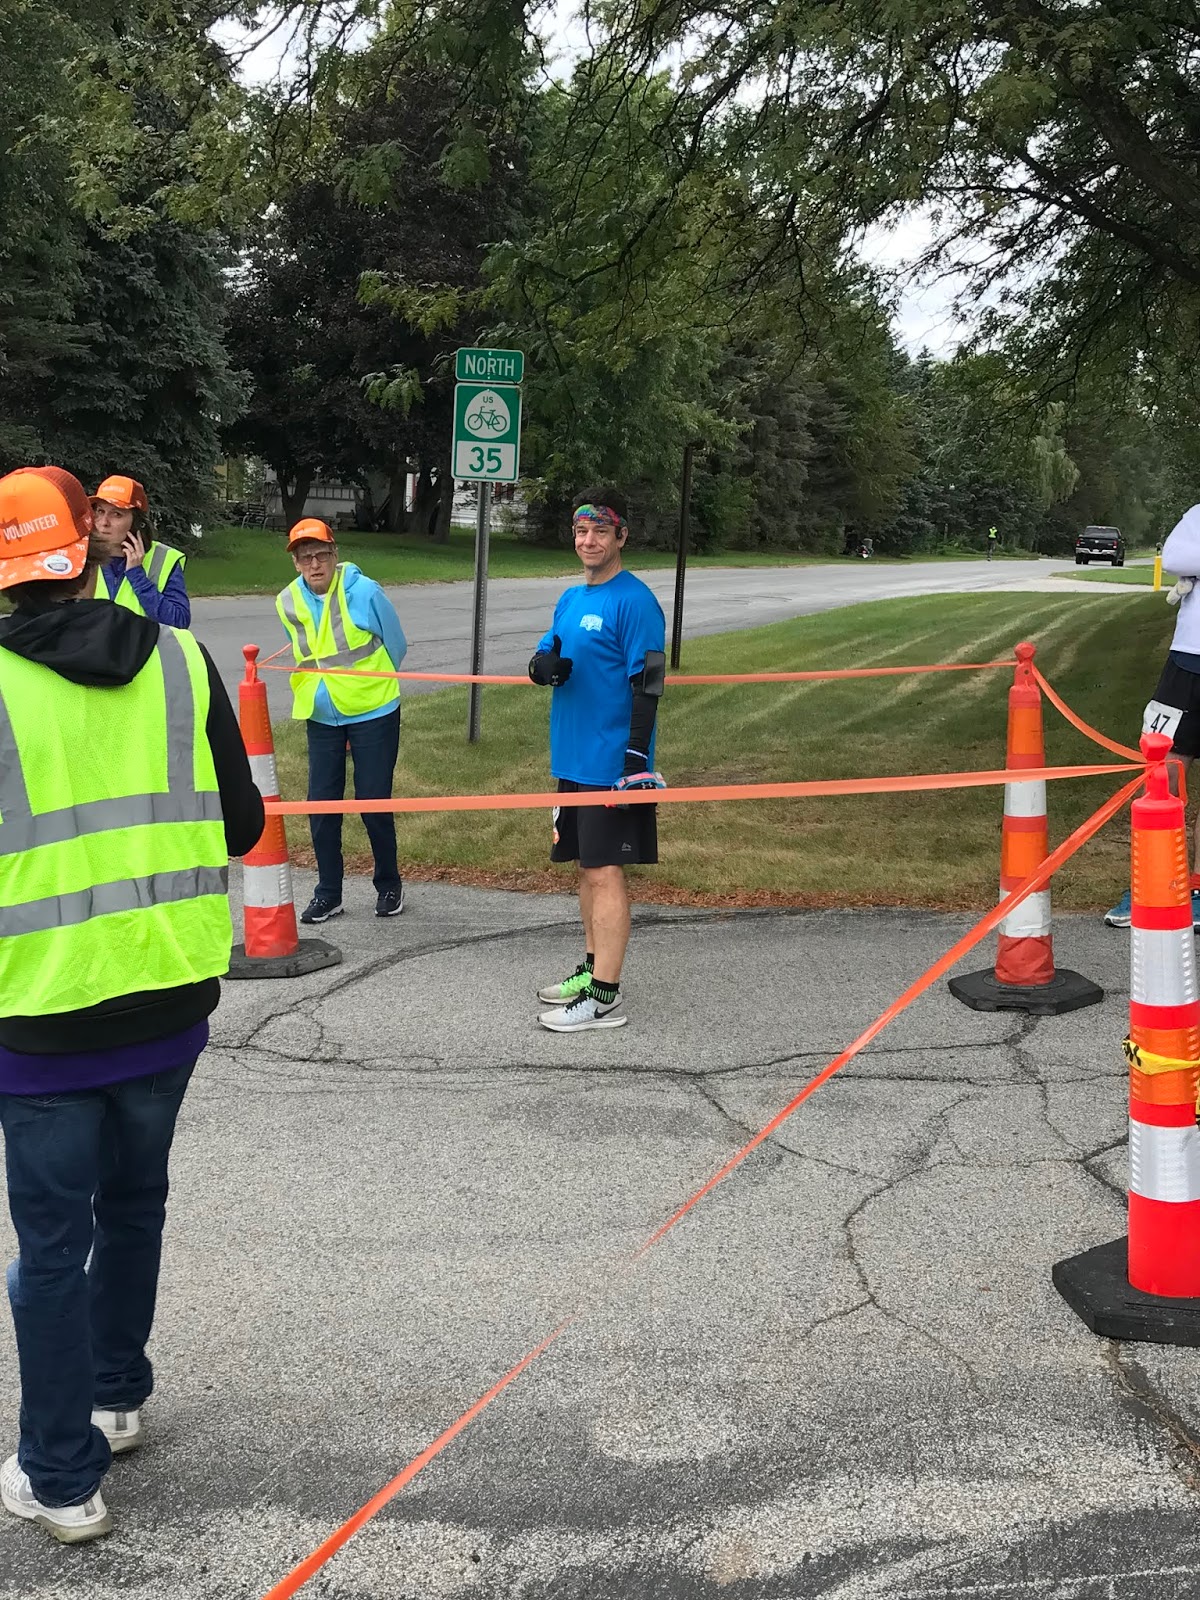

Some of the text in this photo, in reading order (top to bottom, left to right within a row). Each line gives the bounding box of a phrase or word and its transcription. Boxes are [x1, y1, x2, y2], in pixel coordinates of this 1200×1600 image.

[465, 354, 515, 377] NORTH
[482, 396, 494, 404] US
[468, 446, 502, 474] 35
[3, 513, 59, 541] VOLUNTEER
[1150, 713, 1171, 734] 47
